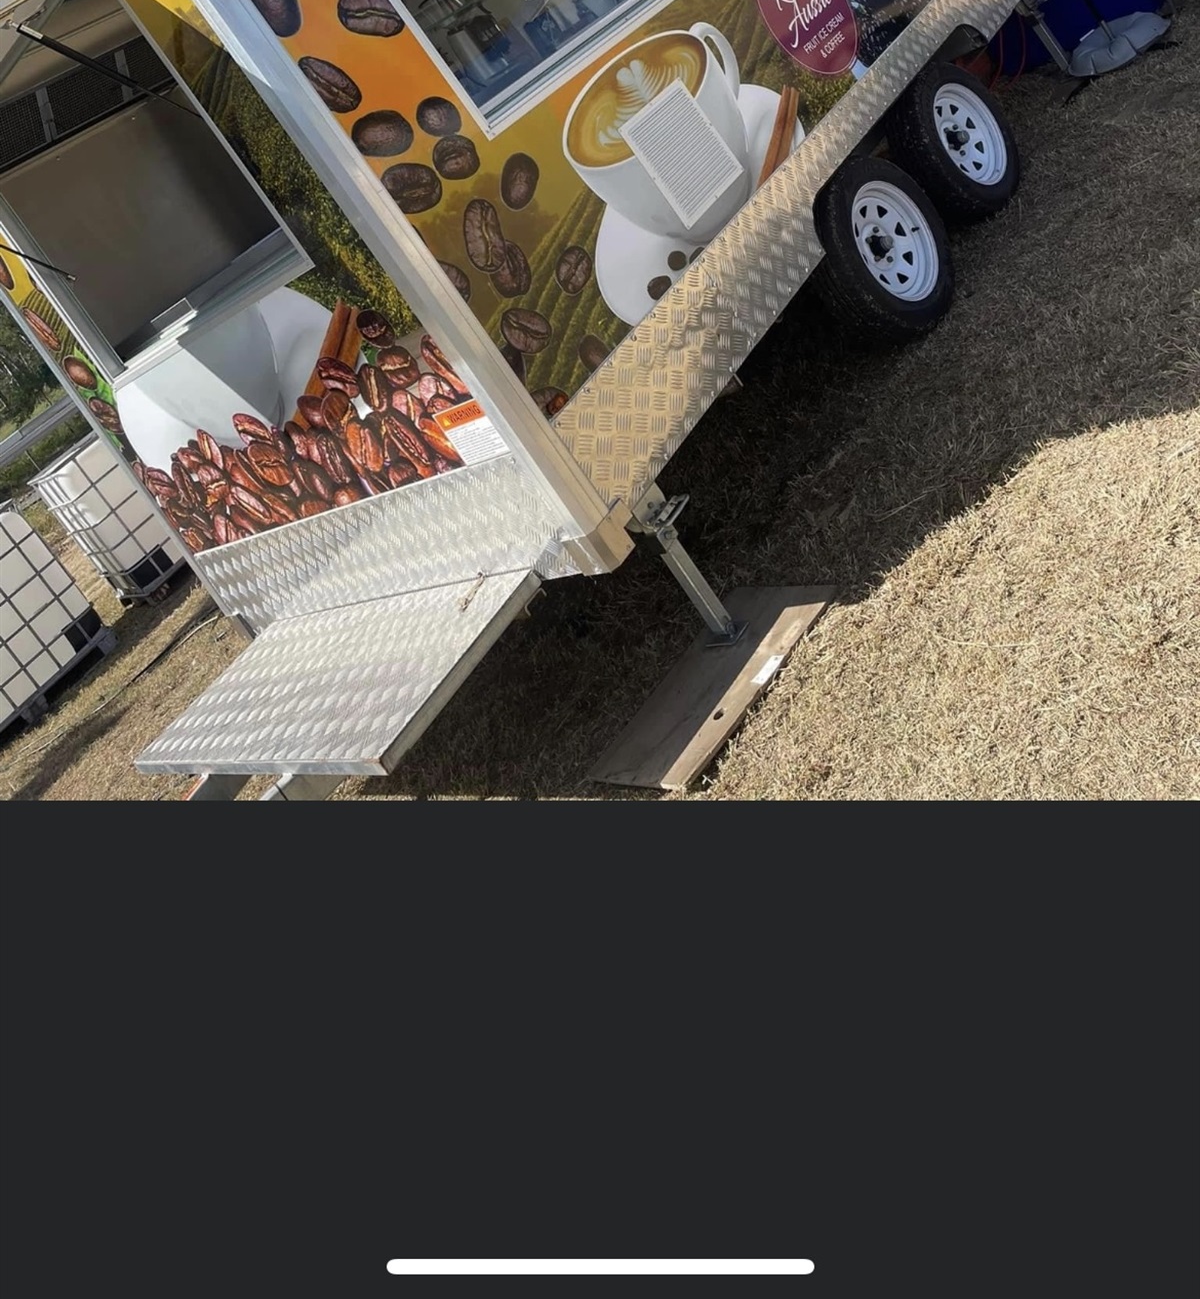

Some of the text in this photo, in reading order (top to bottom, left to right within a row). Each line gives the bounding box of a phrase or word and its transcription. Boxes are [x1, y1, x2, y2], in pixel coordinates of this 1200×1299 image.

[803, 12, 845, 54] FRUIT ICE CREAM
[820, 31, 846, 59] & COFFEE
[447, 405, 481, 423] WARNING
